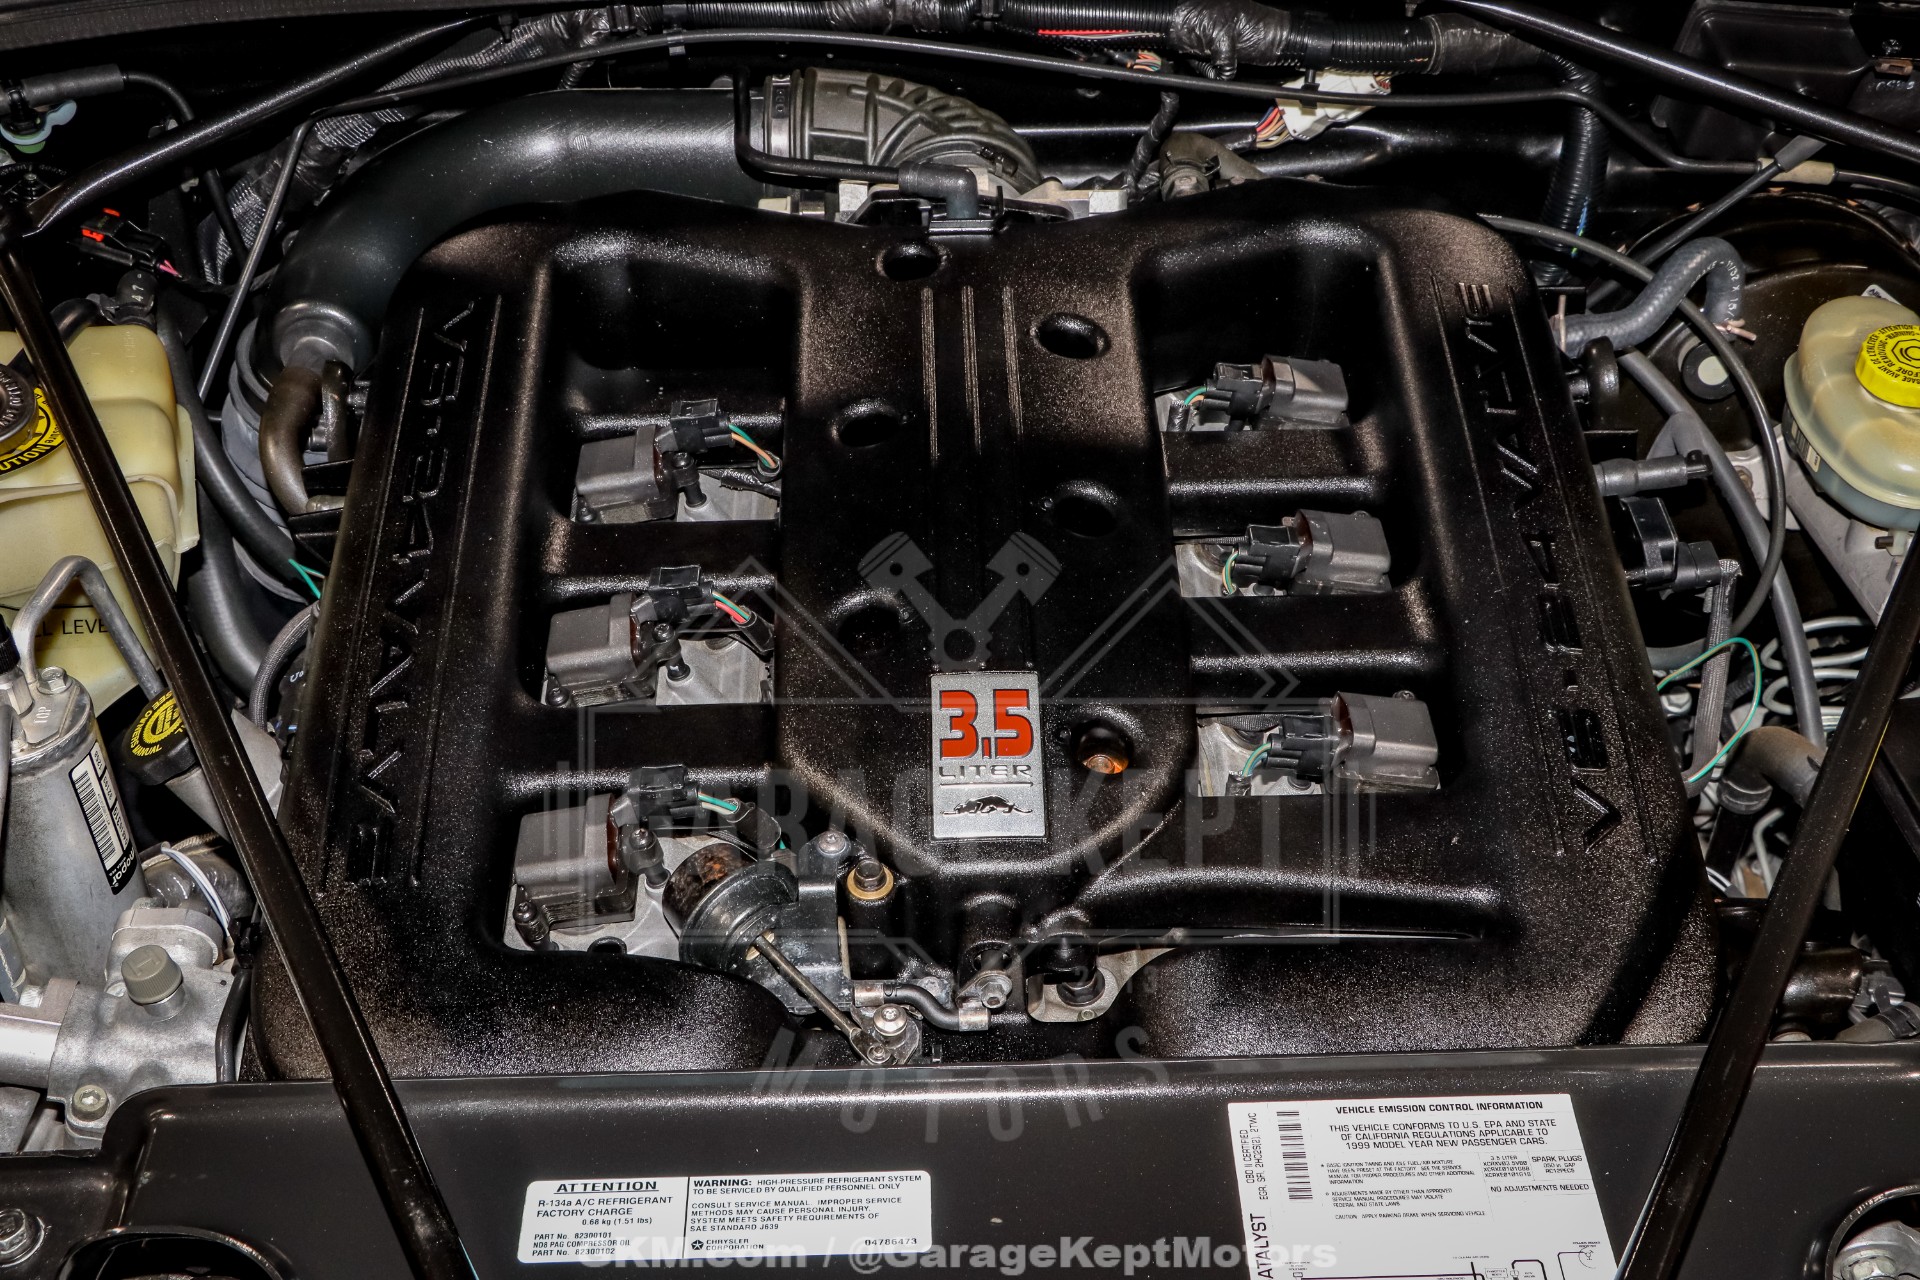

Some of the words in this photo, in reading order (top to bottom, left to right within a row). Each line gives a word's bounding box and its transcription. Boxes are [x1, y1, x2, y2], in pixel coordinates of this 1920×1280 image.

[1878, 366, 1900, 378] AVANT
[62, 619, 109, 635] LEVE
[152, 690, 173, 710] SEE
[131, 710, 152, 748] OWNERS
[939, 689, 1034, 760] 3.5
[132, 744, 163, 757] MANUAL
[938, 764, 1033, 779] LITER
[1336, 1106, 1376, 1114] VEHICLE
[1379, 1104, 1426, 1113] EMISSION
[1429, 1103, 1474, 1112] CONTROL
[1476, 1101, 1543, 1111] INFORMATION
[1352, 1123, 1390, 1132] VEHICLE
[1392, 1122, 1446, 1130] CONFORMS
[1528, 1119, 1556, 1127] STATE
[1356, 1132, 1410, 1140] CALIFORNIA
[1413, 1130, 1476, 1138] REGULATIONS
[1479, 1129, 1534, 1137] APPLICABLE
[1240, 1130, 1252, 1162] CERTIFIED
[1346, 1141, 1370, 1150] 1999
[1373, 1140, 1406, 1149] MODEL
[1410, 1140, 1434, 1148] YEAR
[1462, 1138, 1517, 1146] PASSENGER
[1520, 1137, 1548, 1145] CARS.
[556, 1181, 657, 1192] ATTENTION
[694, 1179, 752, 1187] WARNING:
[757, 1178, 824, 1186] HIGH-PRESSURE
[538, 1198, 572, 1207] R-134a
[575, 1198, 595, 1206] A/C
[598, 1196, 673, 1206] REFRIGERANT
[588, 1208, 633, 1216] CHARGE
